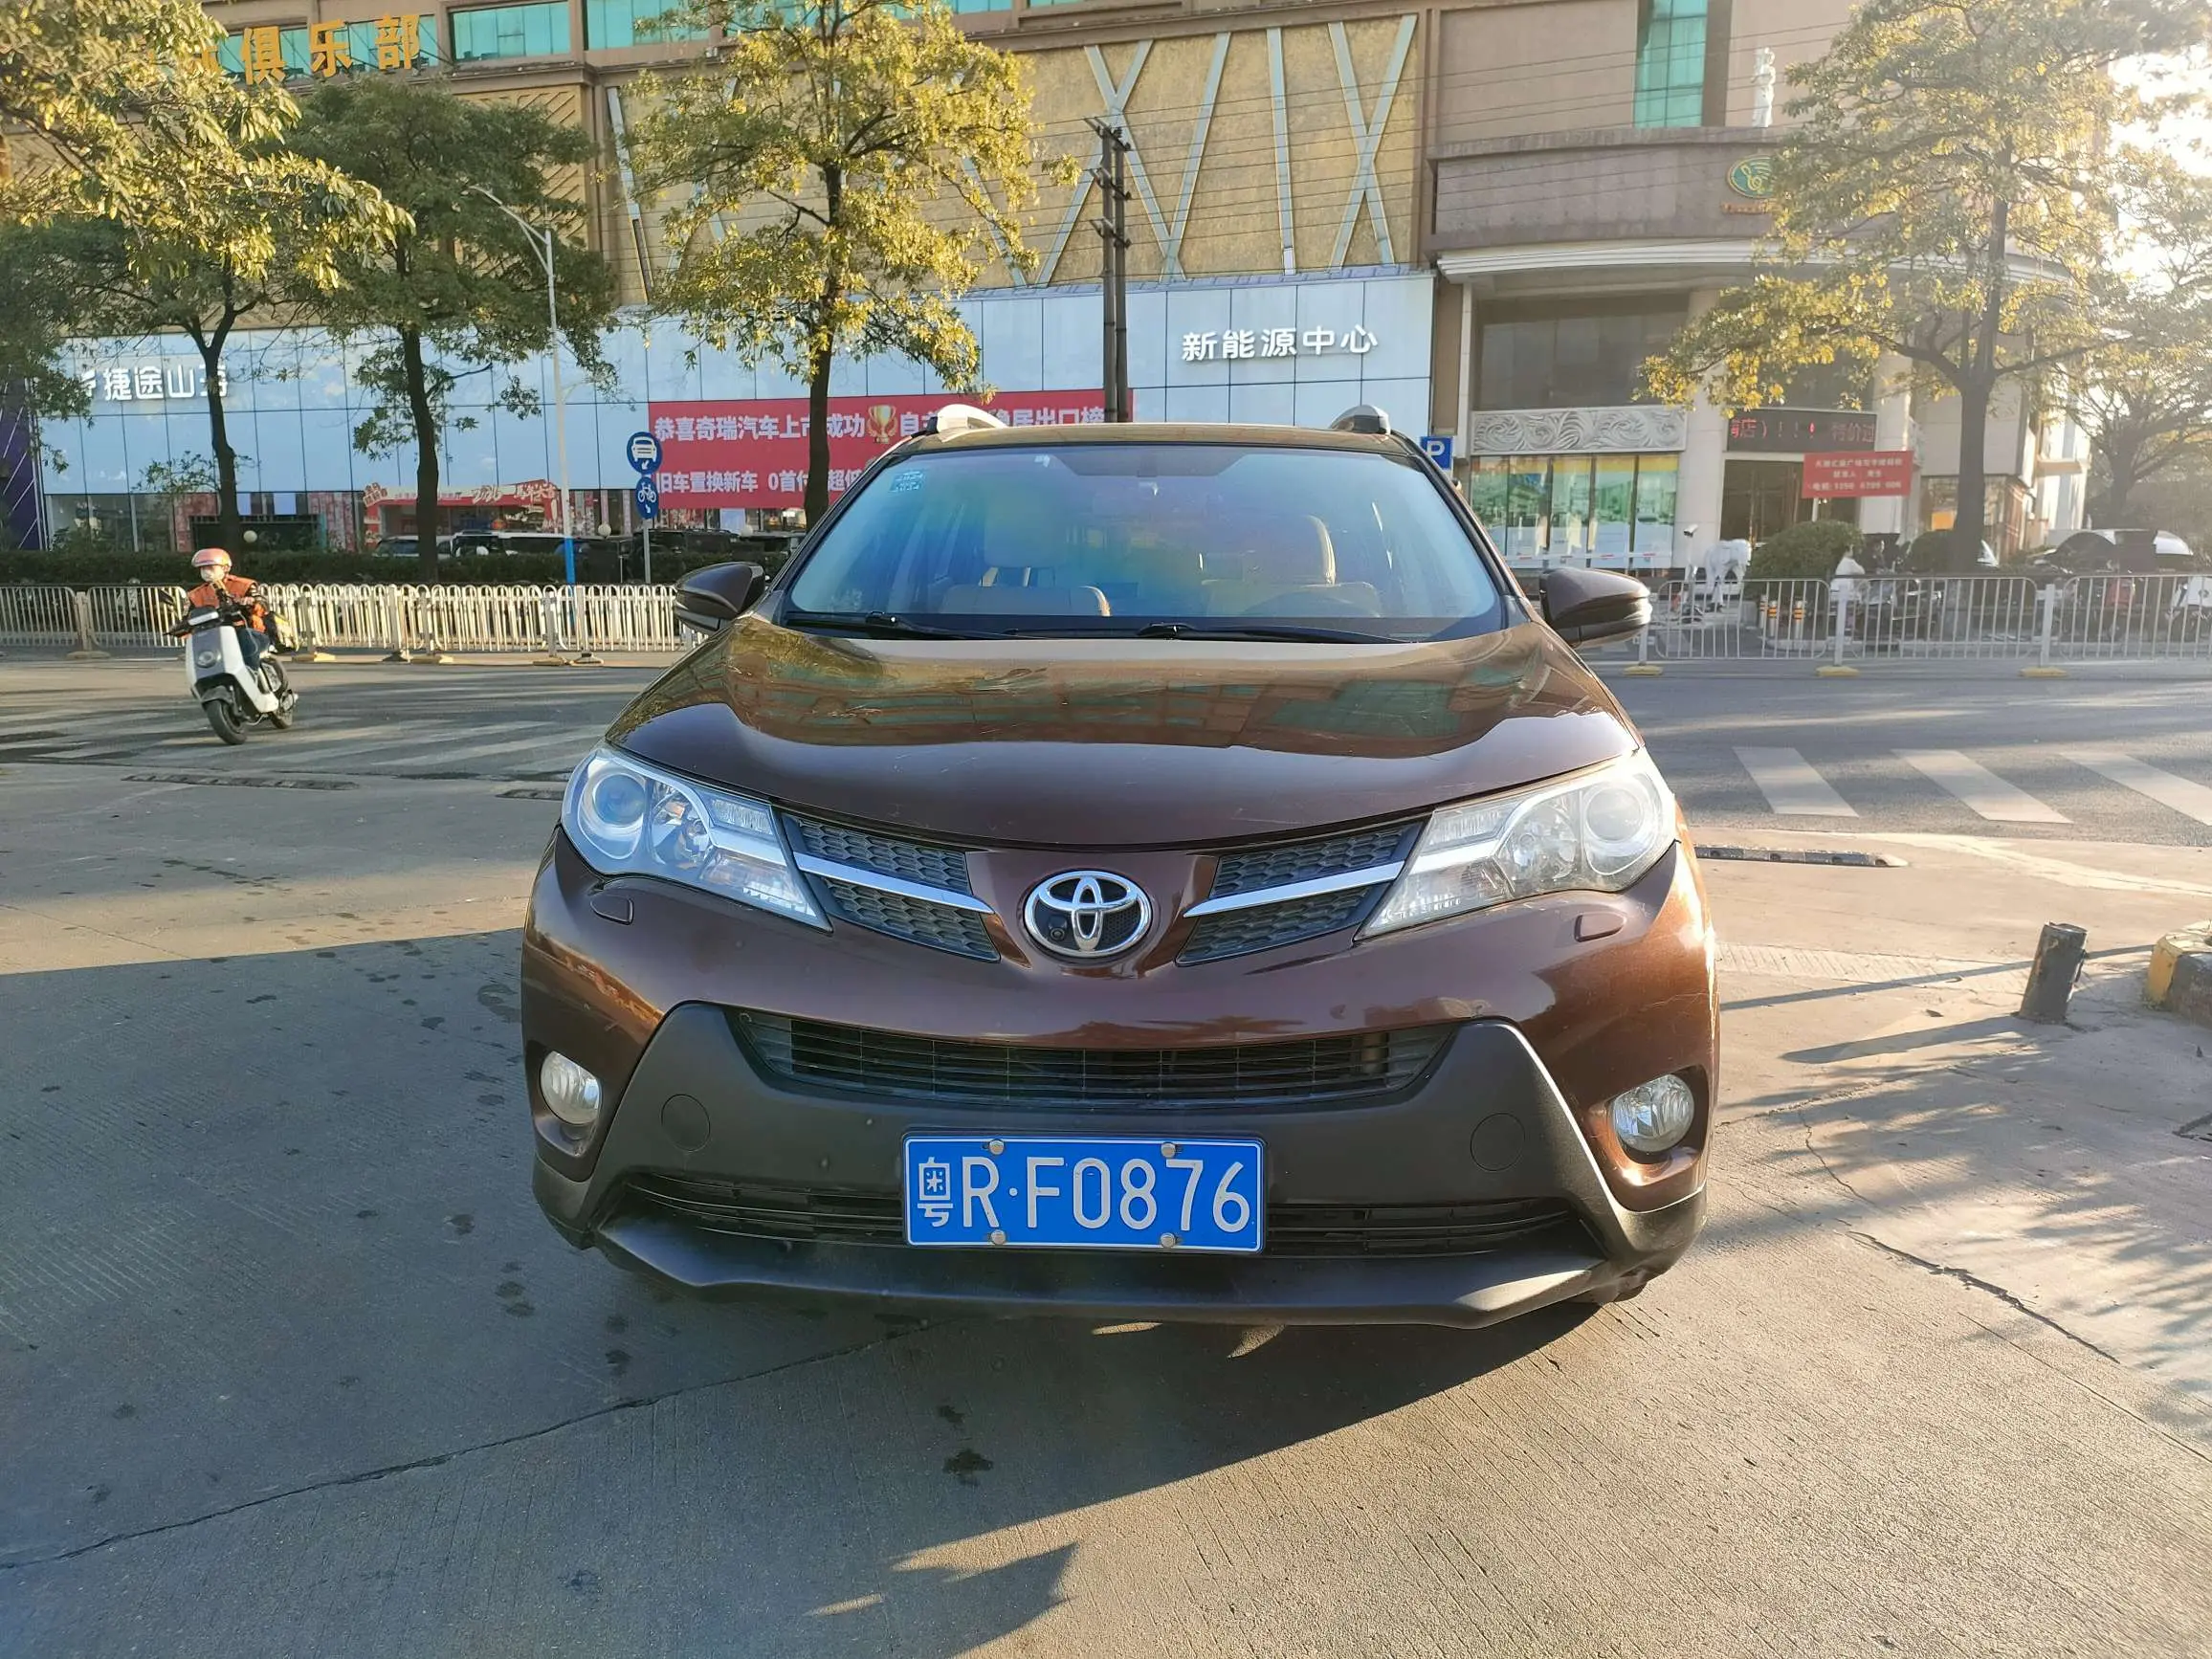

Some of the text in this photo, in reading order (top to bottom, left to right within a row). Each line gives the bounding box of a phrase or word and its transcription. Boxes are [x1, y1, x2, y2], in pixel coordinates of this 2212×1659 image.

[1181, 323, 1379, 362] 新能源中心
[1427, 440, 1446, 457] P
[655, 470, 758, 493] 旧车置换新车
[918, 1156, 1251, 1233] 粤R·F0876
